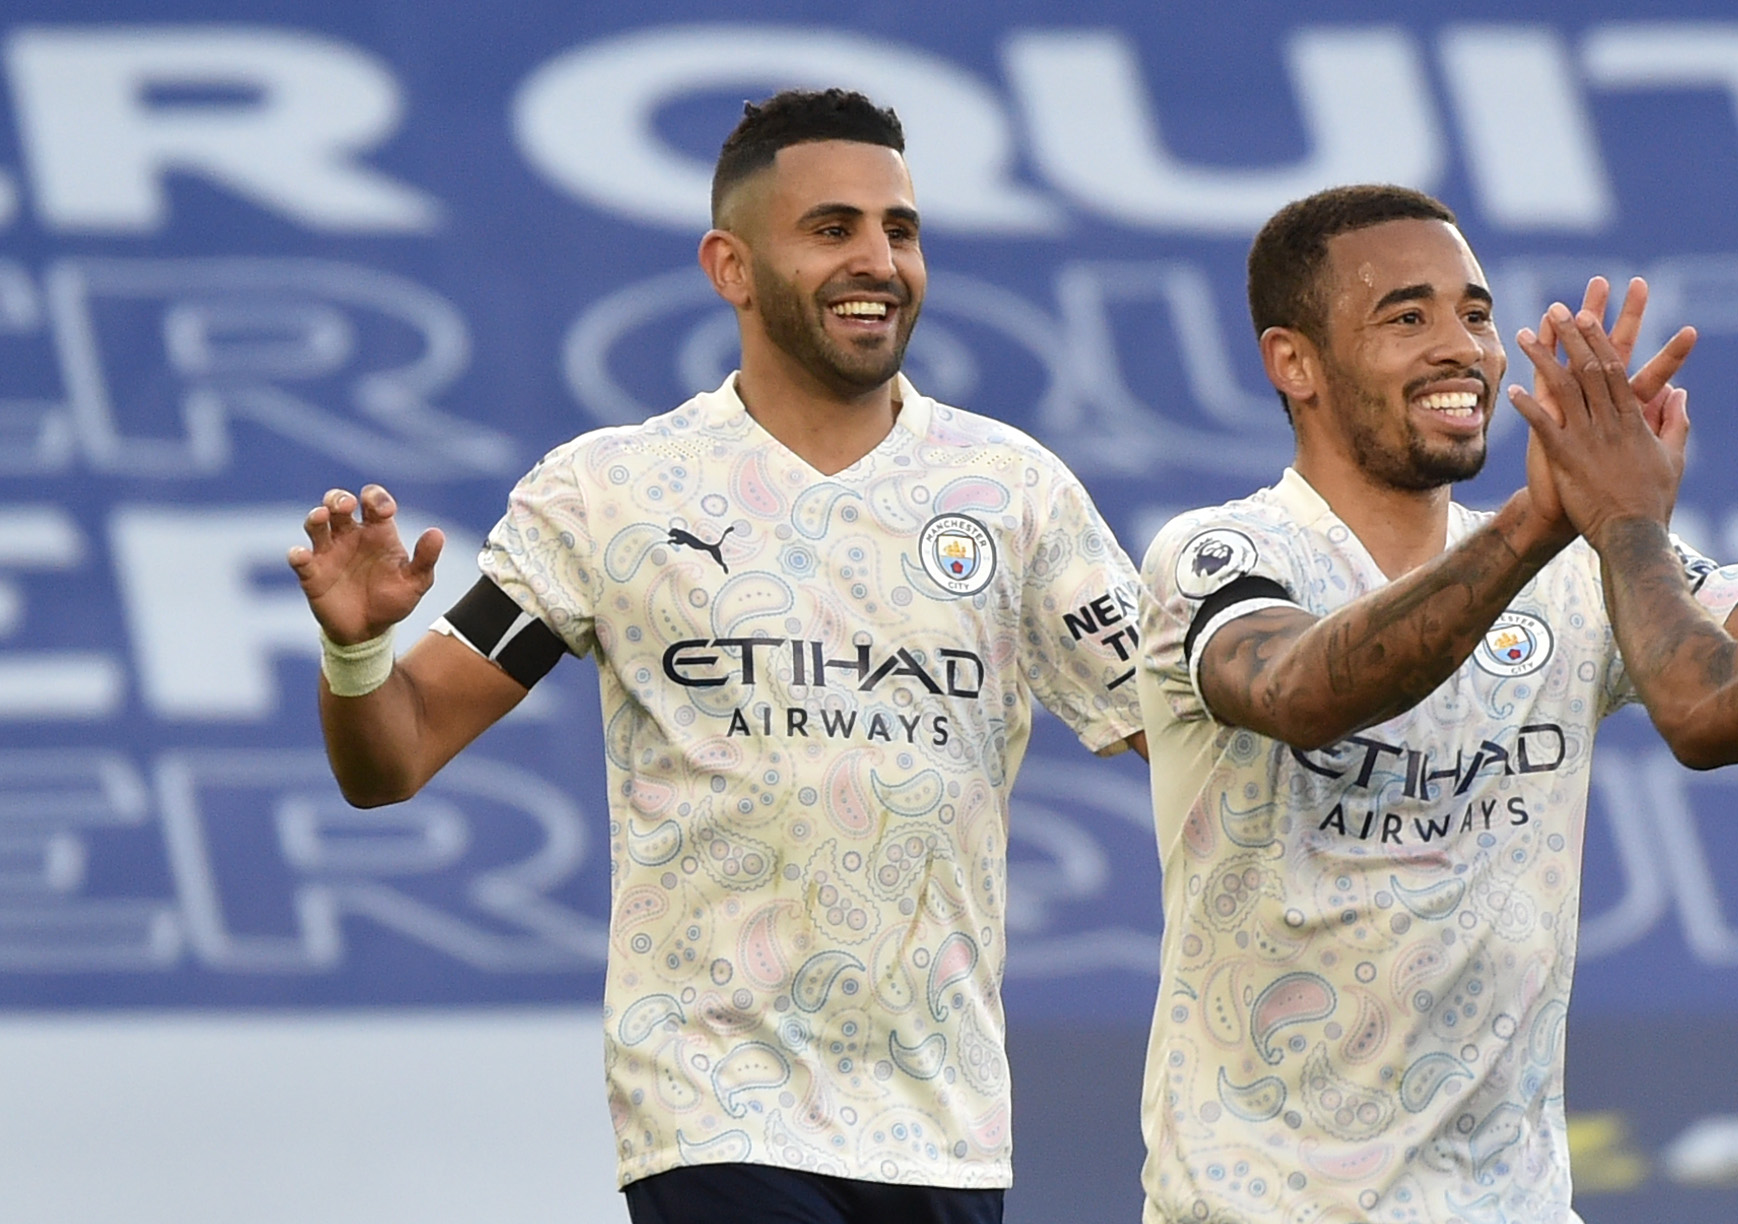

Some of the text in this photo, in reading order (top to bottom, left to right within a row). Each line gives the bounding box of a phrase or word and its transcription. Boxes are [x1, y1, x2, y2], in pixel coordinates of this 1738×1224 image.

[0, 28, 448, 236] R
[926, 520, 987, 547] MANCHESTER
[948, 581, 970, 590] CITY
[1062, 586, 1136, 642] NEX
[1500, 615, 1535, 627] ESTER
[662, 637, 985, 699] ETIHAD
[1511, 662, 1534, 674] CITY
[726, 706, 949, 746] AIRWAYS
[1290, 722, 1567, 801] ETIHAD
[1318, 796, 1530, 845] AIRWAYS
